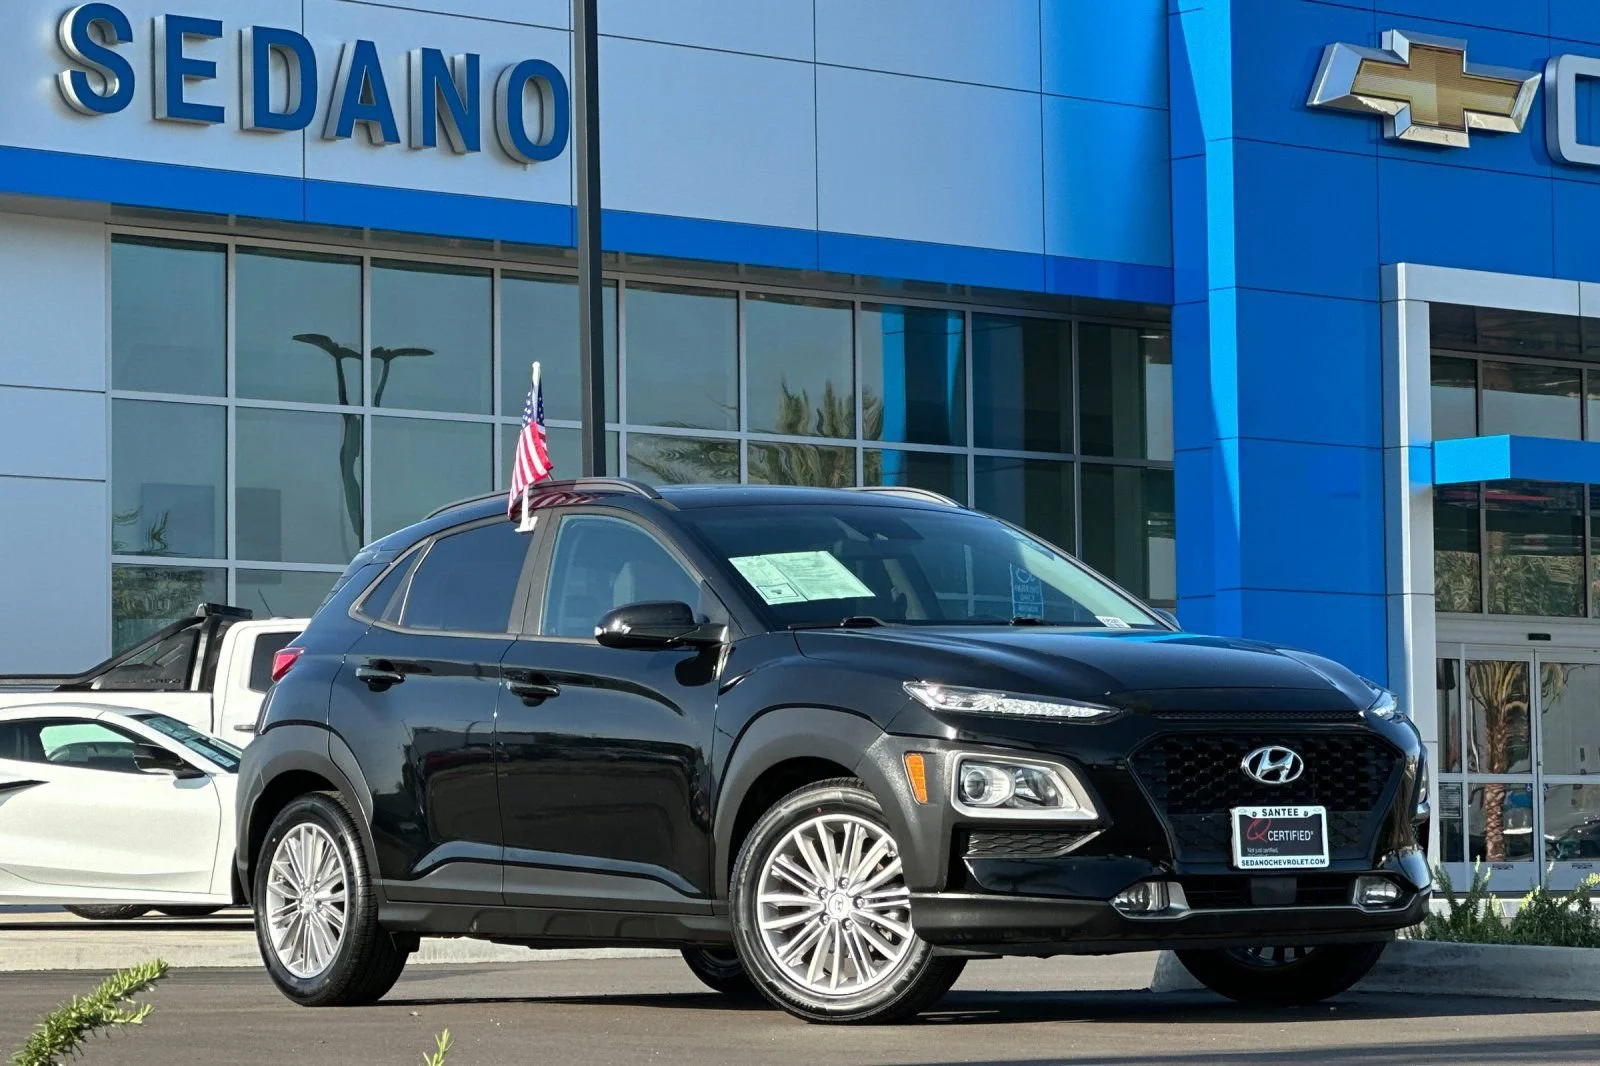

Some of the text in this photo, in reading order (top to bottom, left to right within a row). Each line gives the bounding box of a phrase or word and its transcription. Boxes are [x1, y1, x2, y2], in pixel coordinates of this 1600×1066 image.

[58, 2, 570, 163] SEDANO
[1020, 594, 1035, 602] ONLY
[1261, 808, 1299, 817] SANTEE
[1267, 830, 1311, 842] CERTIFIED
[1241, 858, 1326, 867] SEDANOCHEVROLET.COM
